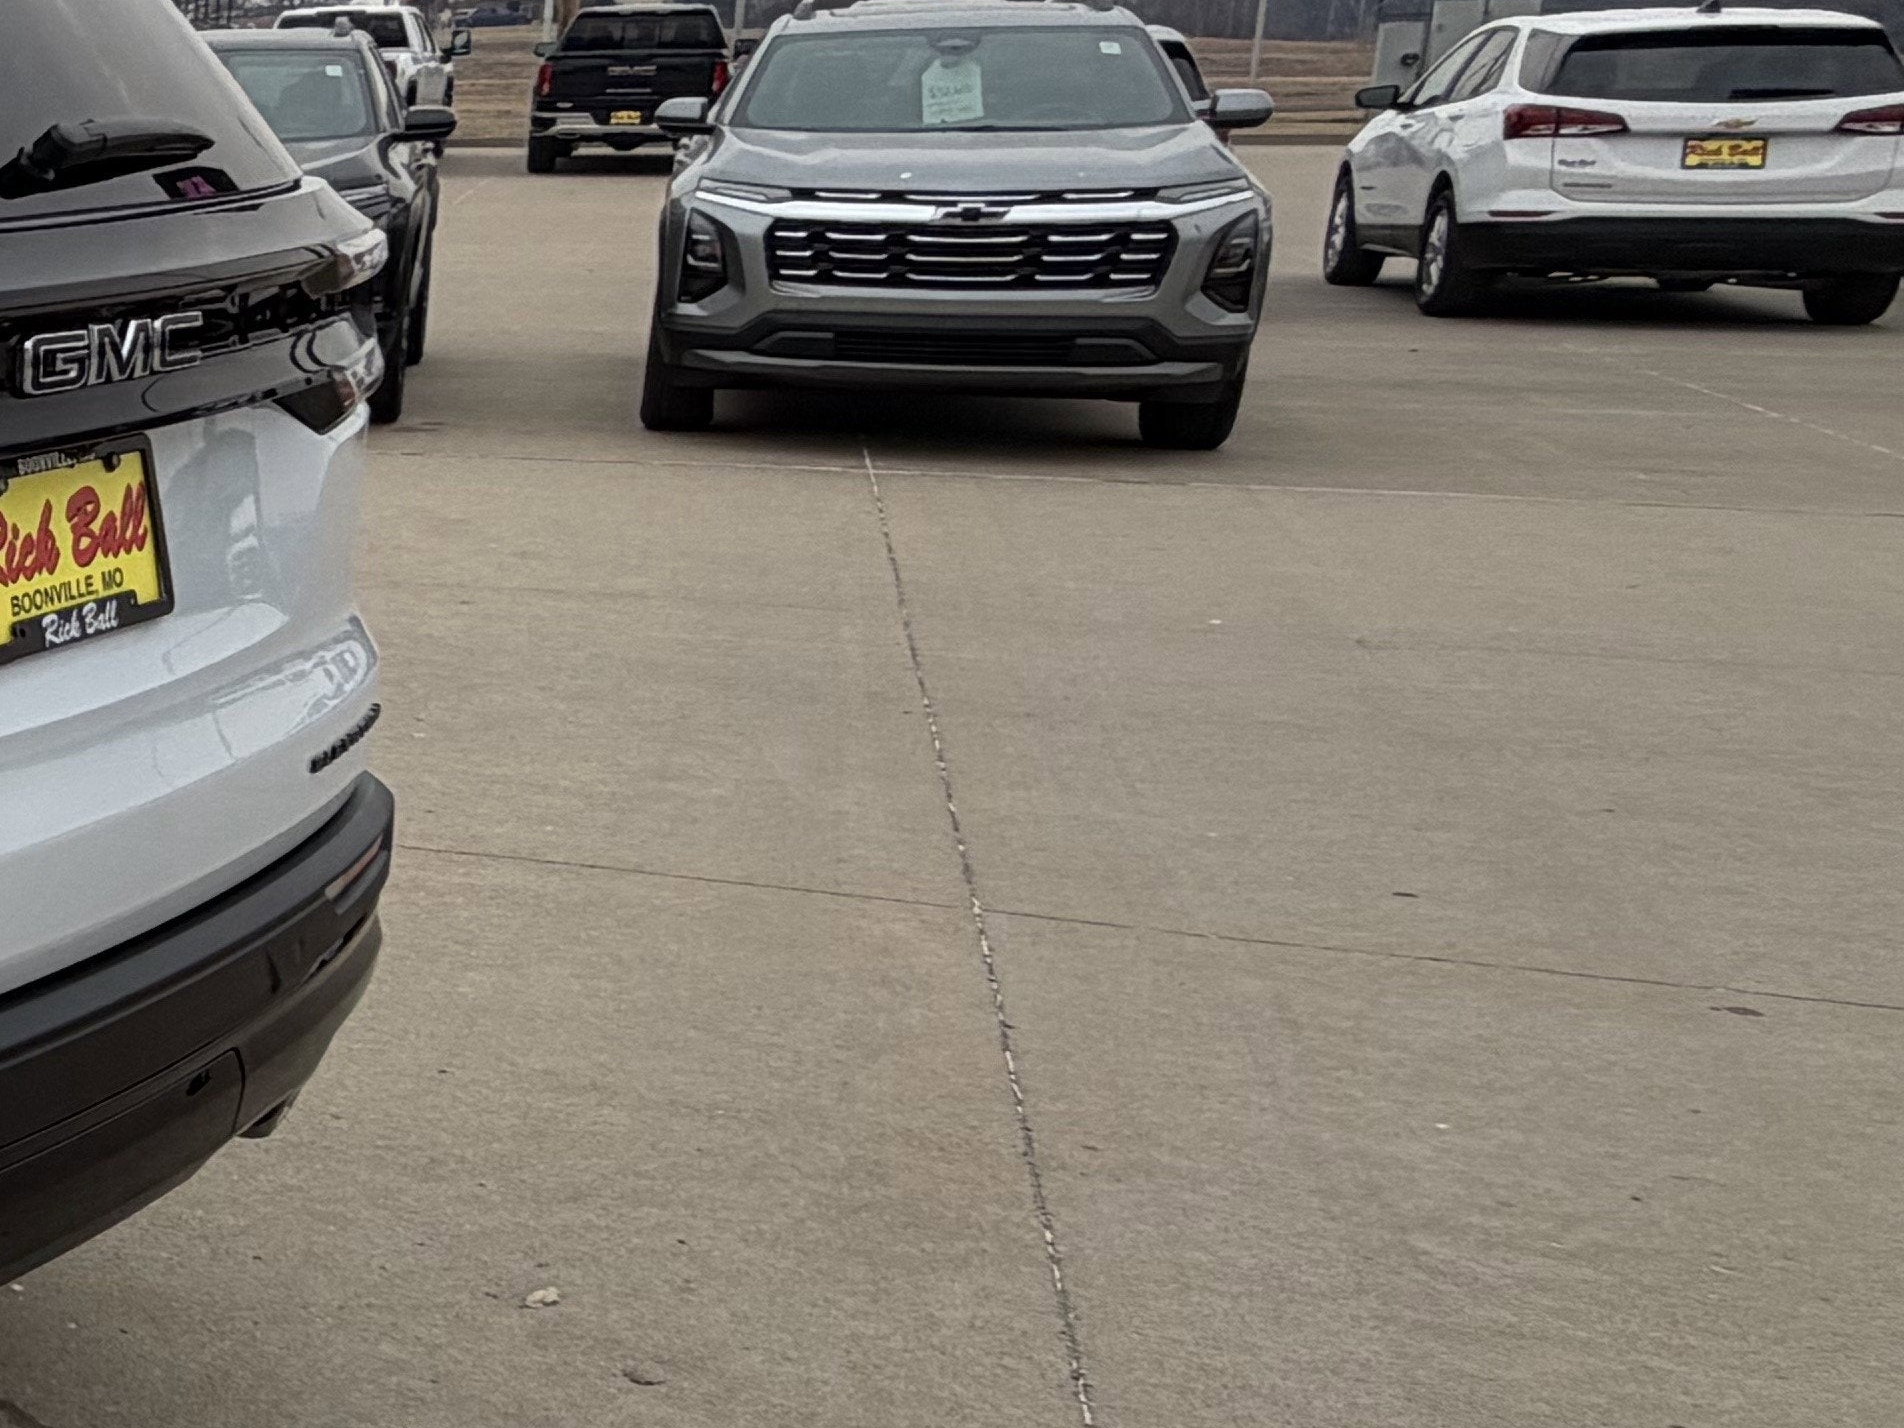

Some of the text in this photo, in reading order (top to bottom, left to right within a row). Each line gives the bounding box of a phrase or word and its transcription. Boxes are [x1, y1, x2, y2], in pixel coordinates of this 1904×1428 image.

[22, 310, 204, 395] GMC
[65, 481, 148, 568] Ball
[10, 567, 124, 616] BOONVILLE, MO
[42, 599, 120, 648] Rick Ball
